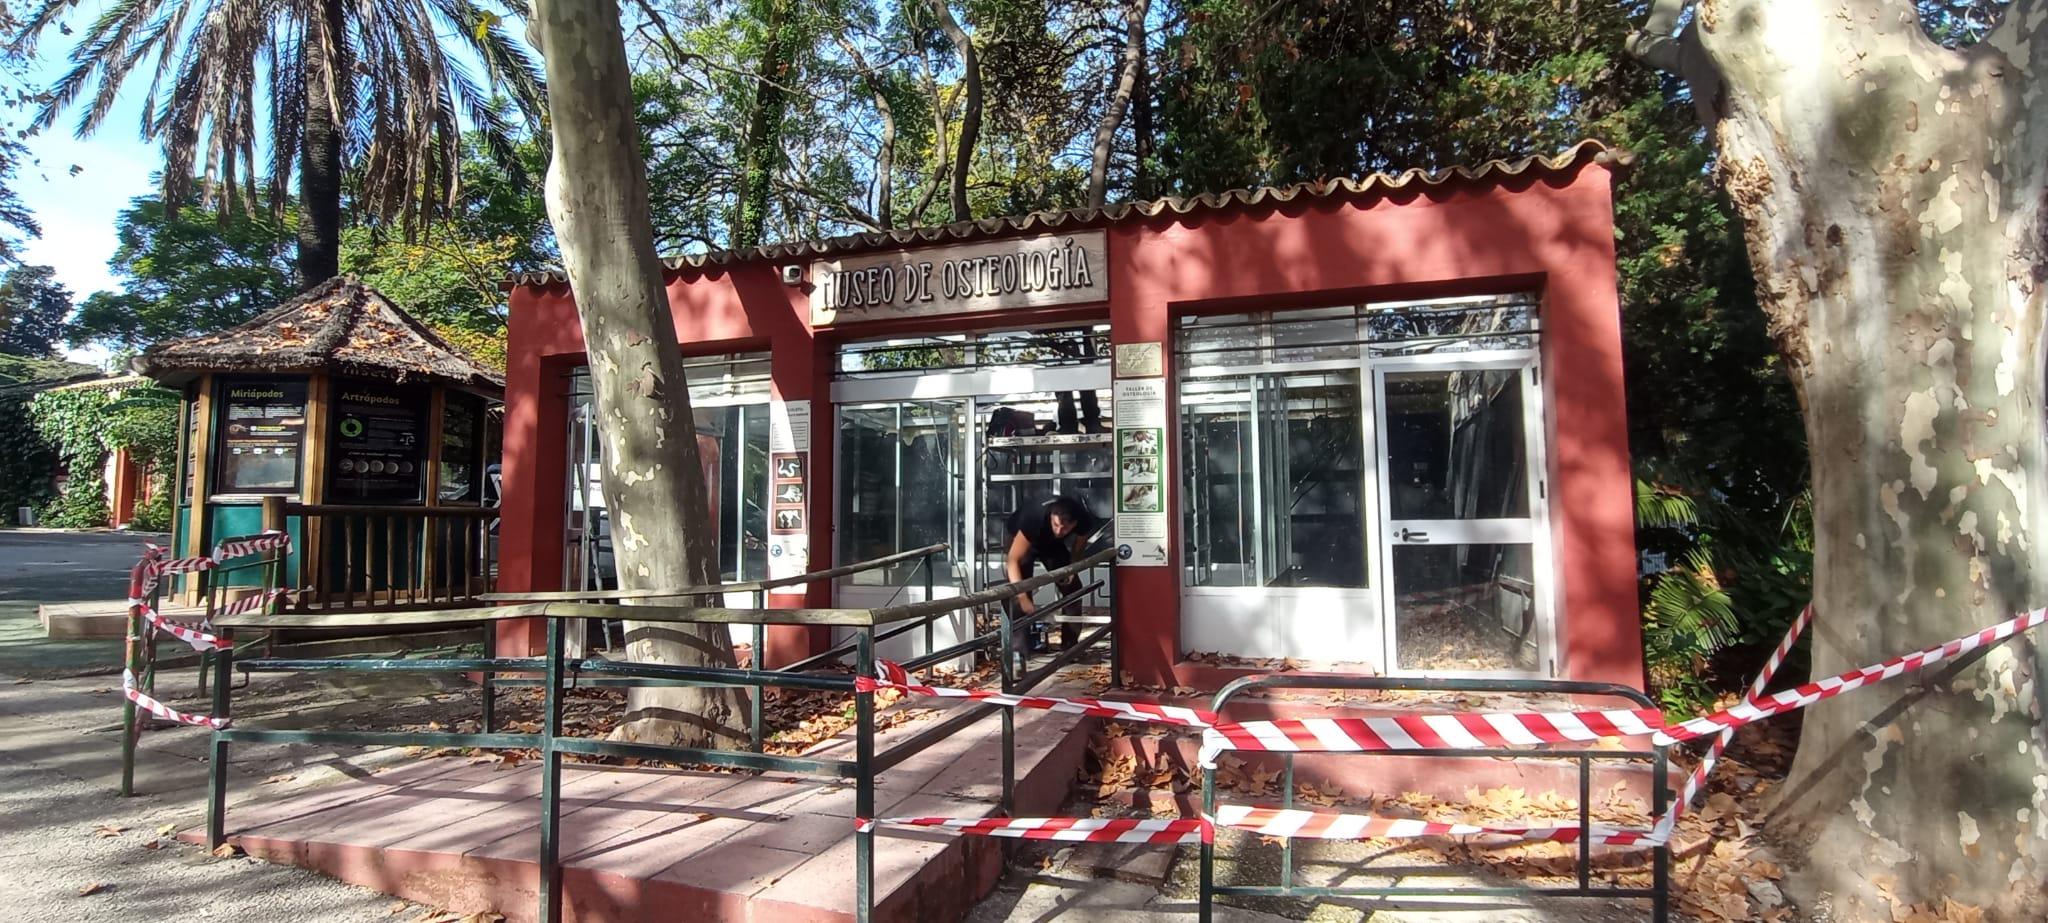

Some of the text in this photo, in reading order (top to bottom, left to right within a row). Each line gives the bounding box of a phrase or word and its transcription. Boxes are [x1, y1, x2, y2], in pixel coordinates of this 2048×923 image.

[820, 238, 1093, 311] MUSEO DE OSTEOLOGÍA
[231, 389, 284, 400] Miriápodos
[342, 392, 400, 405] Artrópodos
